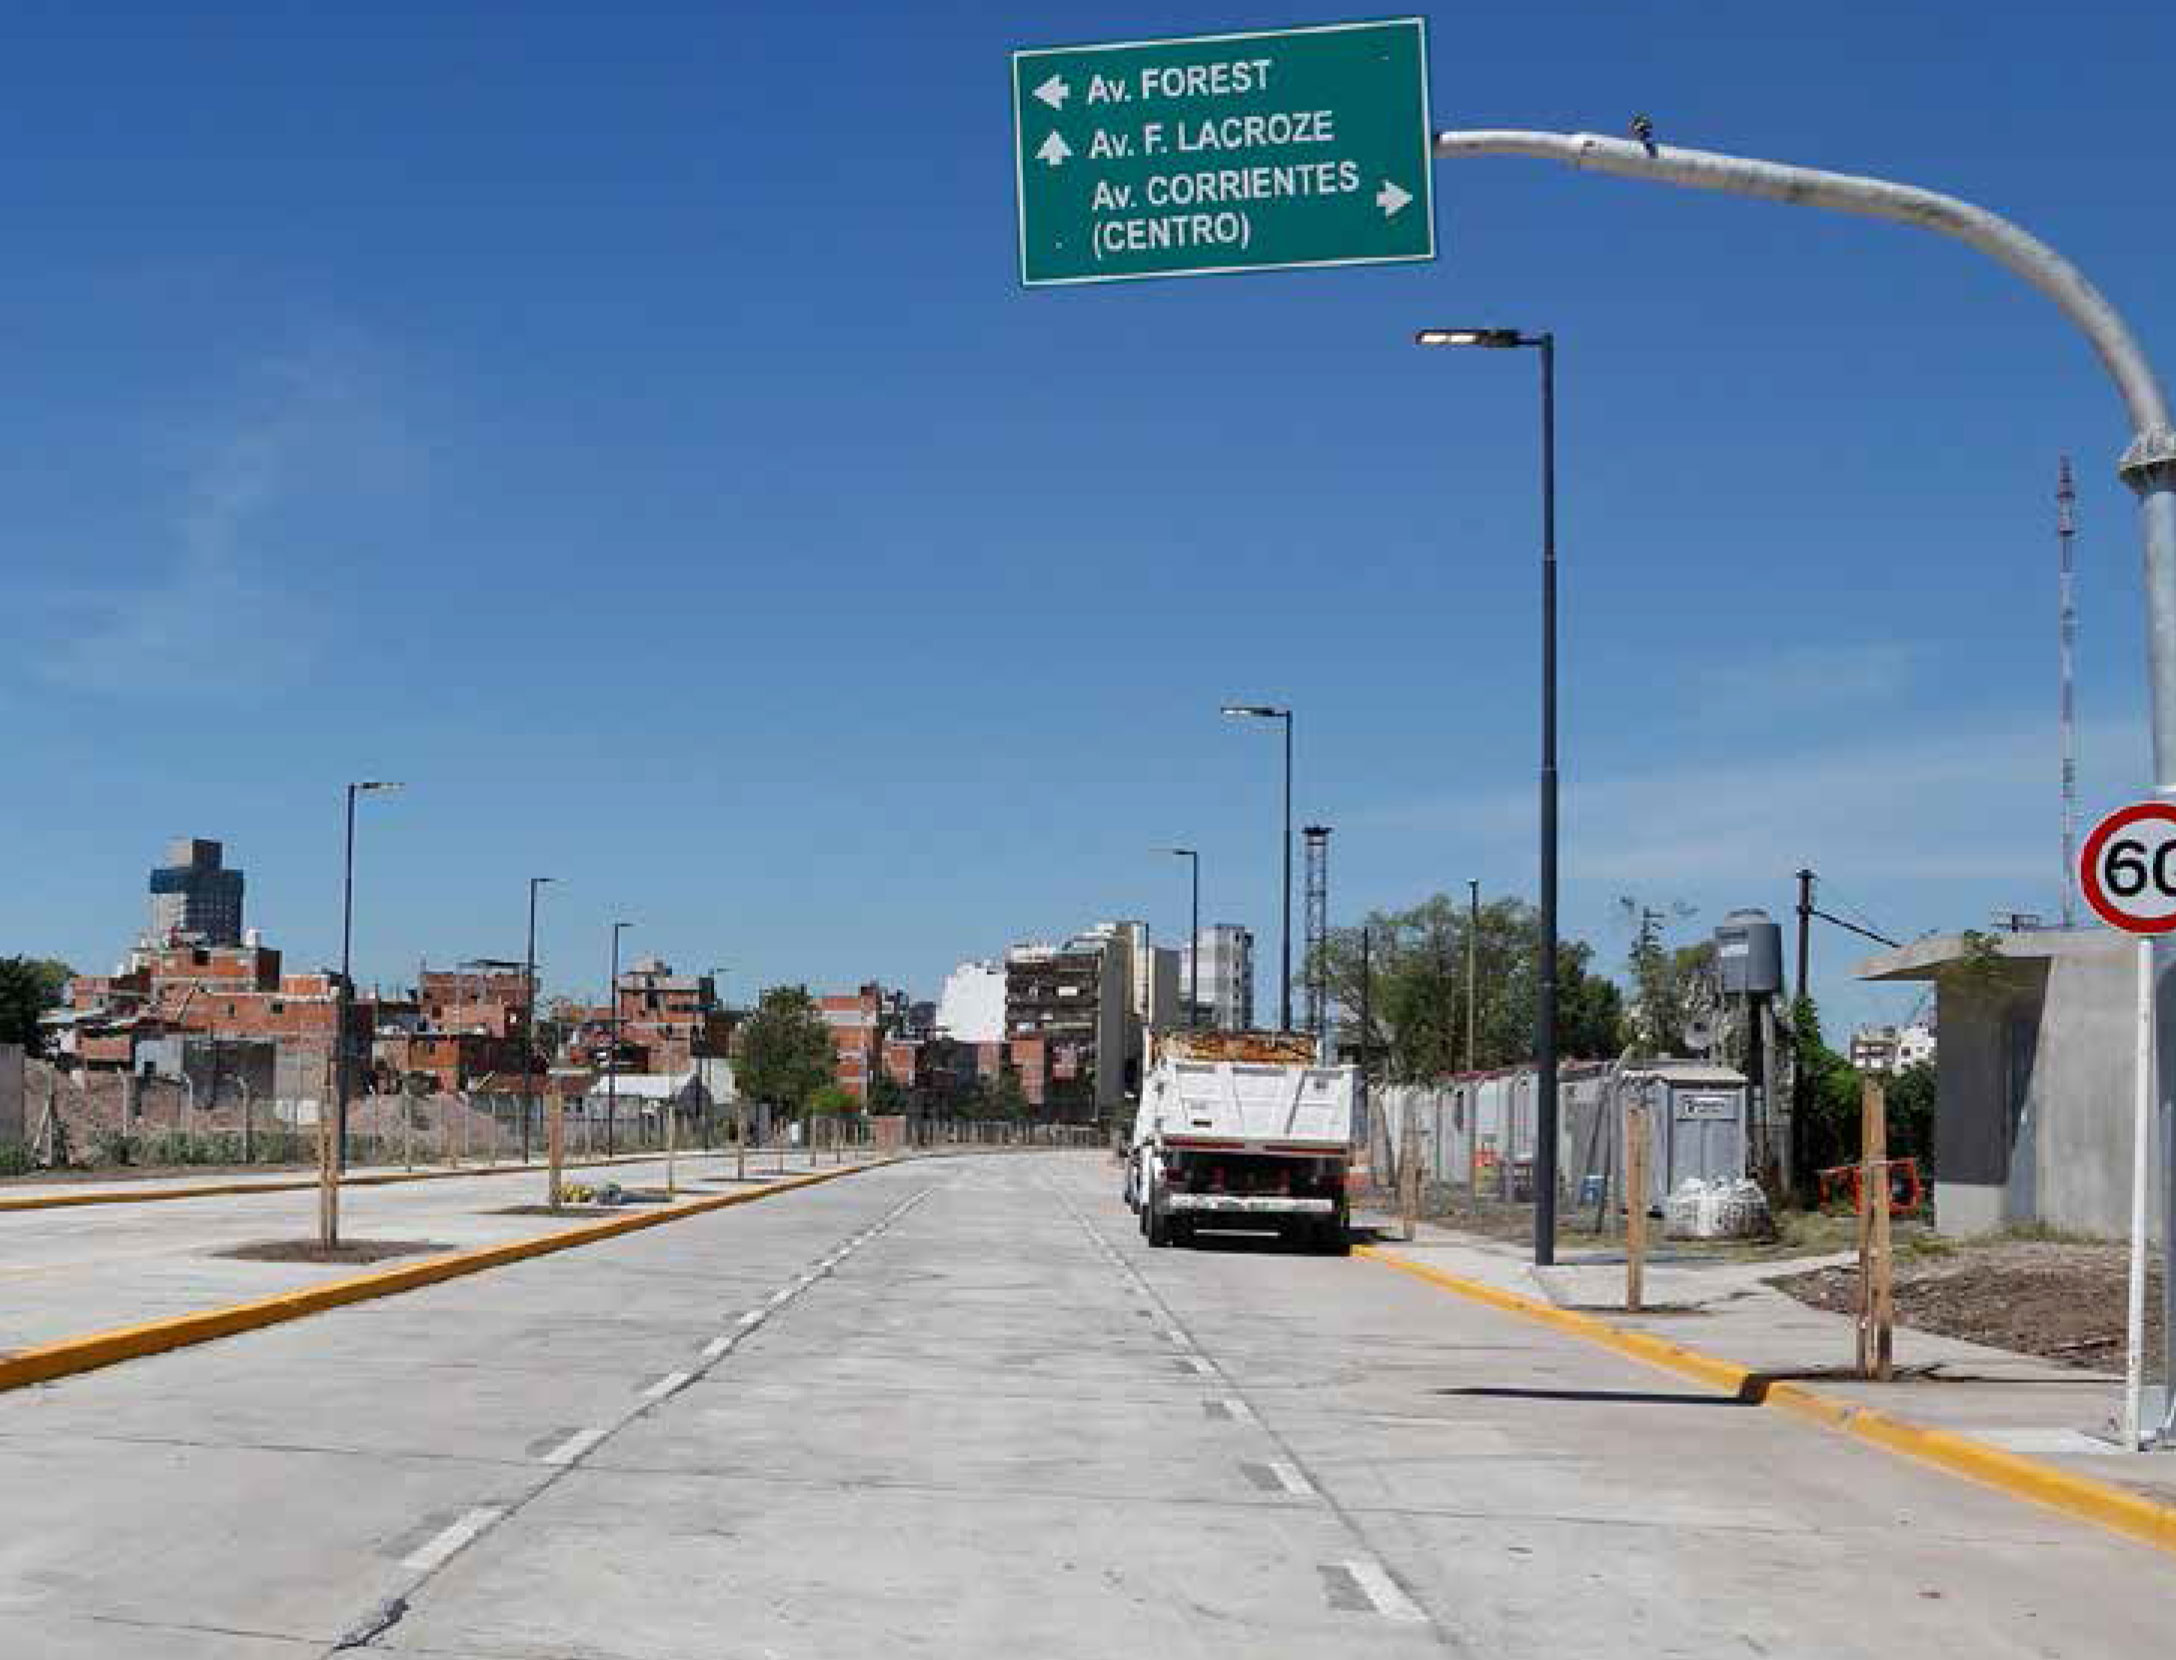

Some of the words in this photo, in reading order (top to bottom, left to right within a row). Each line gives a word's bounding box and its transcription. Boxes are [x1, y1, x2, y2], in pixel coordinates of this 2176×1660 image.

[1088, 74, 1131, 105] Av.
[1141, 59, 1271, 100] FOREST
[1089, 129, 1134, 159] Av.
[1144, 123, 1167, 154] F.
[1178, 110, 1334, 152] LACROZE
[1092, 181, 1137, 211] Av.
[1147, 161, 1360, 207] CORRIENTES
[1093, 212, 1250, 260] (CENTRO)
